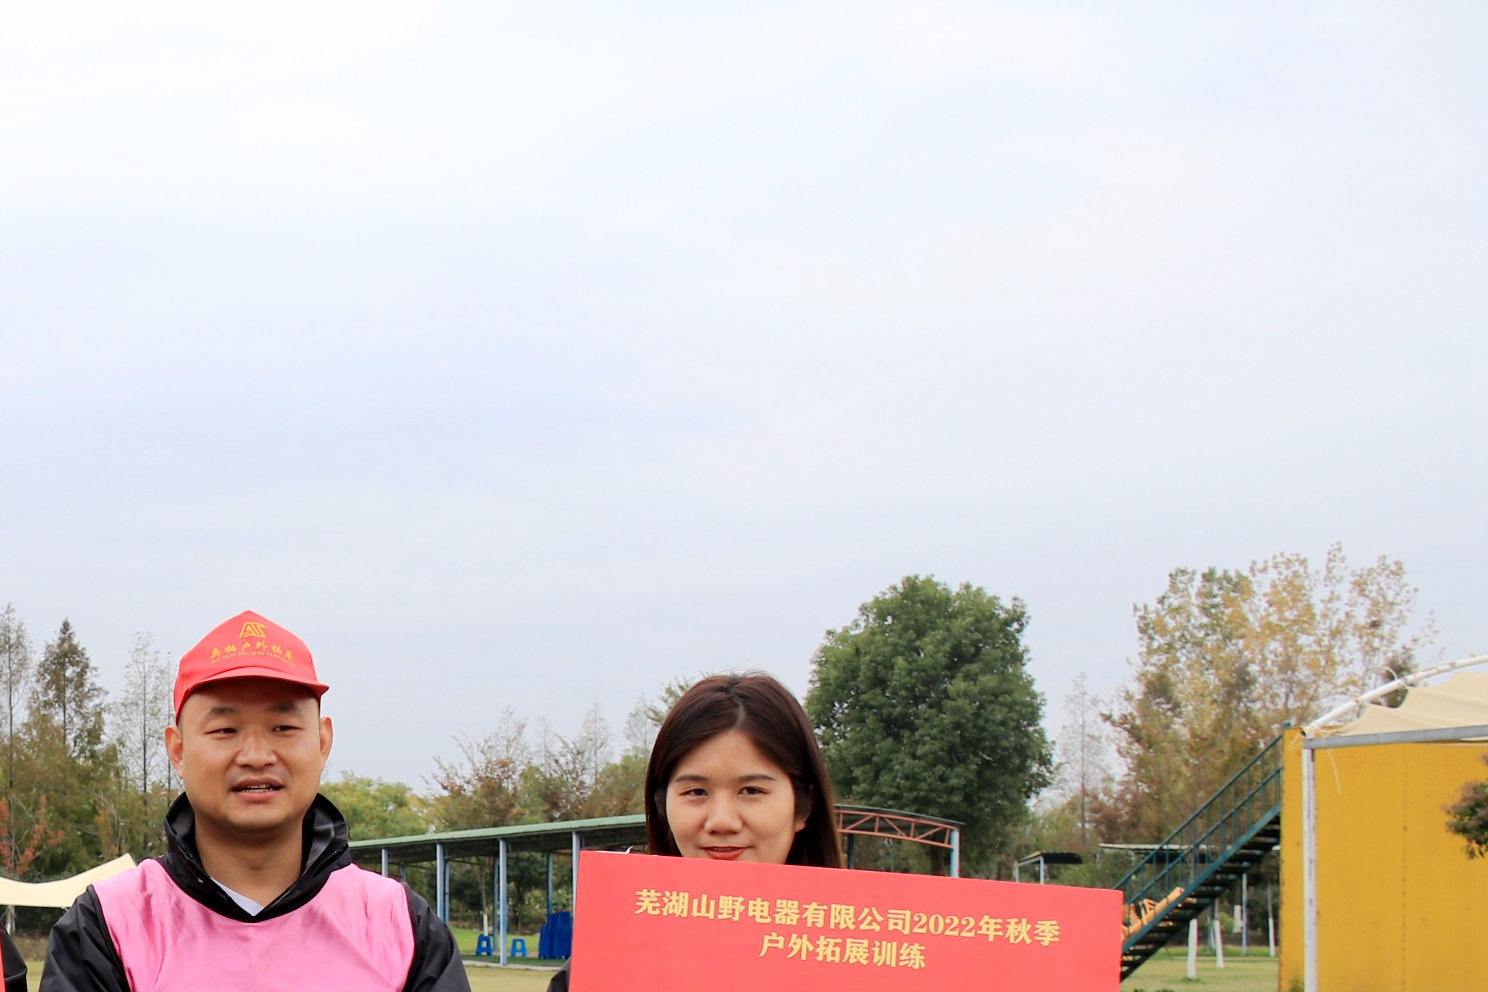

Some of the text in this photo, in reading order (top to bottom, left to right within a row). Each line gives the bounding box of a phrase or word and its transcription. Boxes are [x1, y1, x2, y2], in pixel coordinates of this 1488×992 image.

[636, 889, 1060, 946] 芜湖山野电器有限公司2022年秋季
[760, 932, 926, 969] 户外拓展训练
